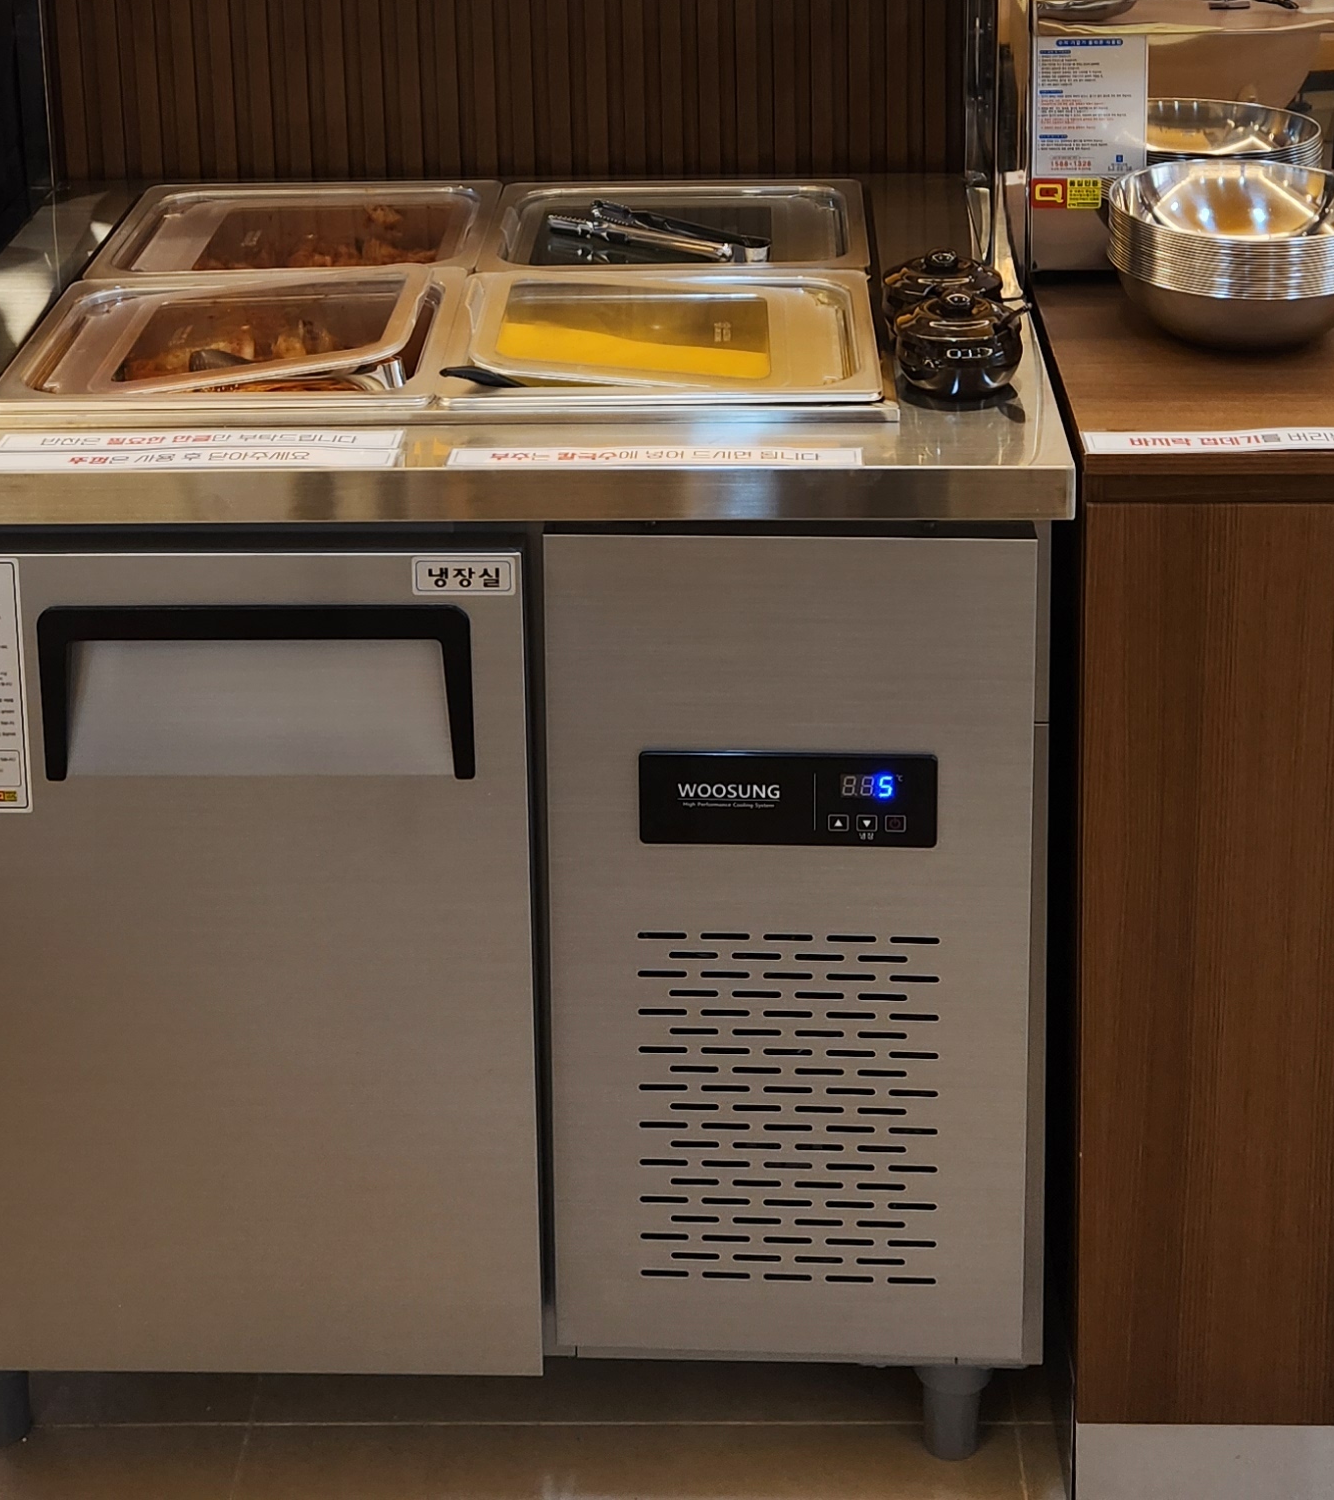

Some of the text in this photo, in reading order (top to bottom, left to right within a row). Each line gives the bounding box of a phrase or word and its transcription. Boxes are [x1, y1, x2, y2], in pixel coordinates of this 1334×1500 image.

[107, 436, 166, 446] 필요한
[239, 434, 357, 444] 부탁드립니다
[1129, 437, 1191, 447] 바지락
[134, 453, 176, 463] 사용
[181, 452, 203, 461] 후
[207, 451, 310, 461] 닫아주세요
[491, 452, 550, 461] 부추는
[557, 450, 638, 461] 칼국수에
[691, 450, 752, 460] 드시면
[428, 567, 500, 588] 냉장실
[677, 783, 780, 799] WOOSUNG
